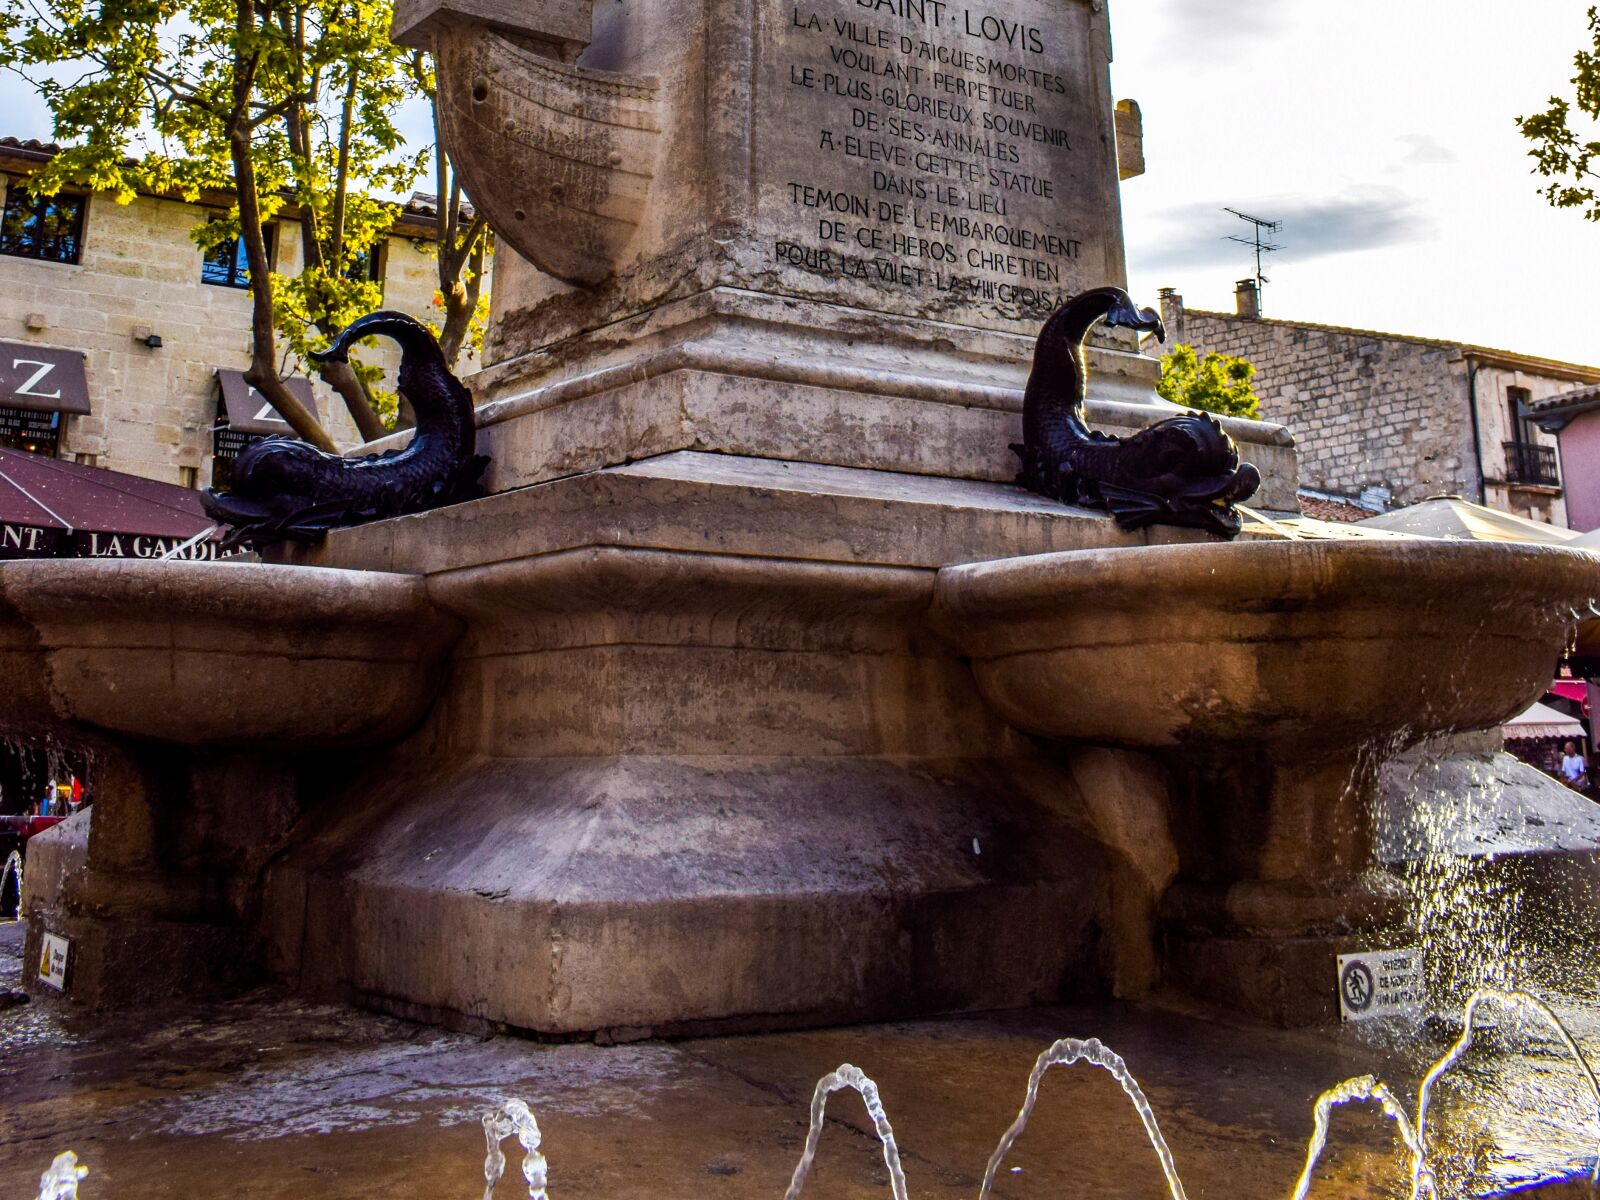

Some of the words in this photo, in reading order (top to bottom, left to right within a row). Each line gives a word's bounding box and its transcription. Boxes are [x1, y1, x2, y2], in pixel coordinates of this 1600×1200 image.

[794, 8, 822, 33] LA
[834, 18, 889, 50] VILLE
[964, 9, 1044, 54] LOVIS
[830, 45, 923, 85] VOULANT
[934, 72, 1037, 114] PERPETUER
[791, 65, 814, 88] LE
[824, 73, 871, 102] PLUS
[882, 87, 974, 125] GLORIEUX
[983, 111, 1071, 149] SOUVENIR
[852, 108, 878, 132] DE
[888, 117, 925, 142] SES
[933, 128, 1020, 164] ANNALES
[845, 136, 905, 167] ELEVE
[915, 152, 979, 182] CETTE
[989, 168, 1053, 199] STATUE
[788, 182, 869, 218] TEMOIN
[878, 201, 904, 225] DE
[873, 171, 927, 198] DANS
[937, 184, 958, 207] LE
[968, 193, 1007, 216] LIEU
[775, 241, 833, 273] POUR
[841, 254, 869, 280] LA
[936, 272, 960, 293] LA
[819, 219, 846, 244] DE
[857, 227, 883, 250] CE
[892, 232, 957, 264] HEROS
[967, 248, 1059, 284] CHRETIEN
[13, 358, 61, 399] Z
[88, 533, 125, 557] LA
